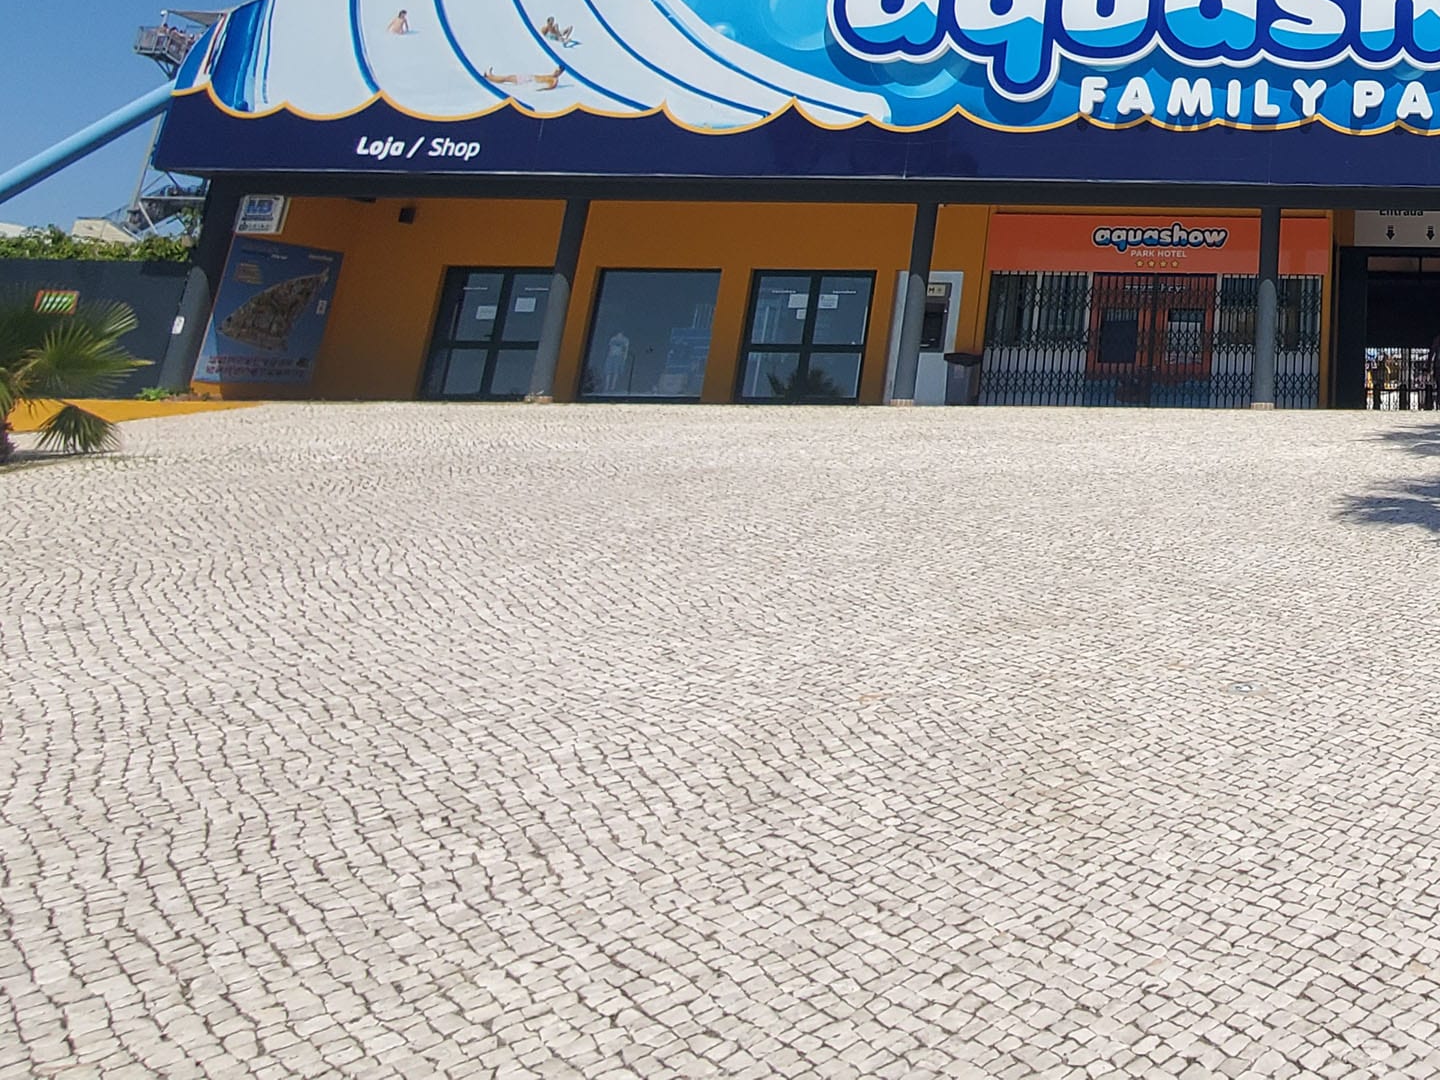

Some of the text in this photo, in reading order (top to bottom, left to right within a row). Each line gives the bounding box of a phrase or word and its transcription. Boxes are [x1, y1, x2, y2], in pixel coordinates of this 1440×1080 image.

[1079, 77, 1327, 117] FAMILY
[356, 136, 480, 161] Loja / Shop
[1094, 223, 1227, 252] aquashow
[1158, 250, 1187, 258] HOTEL
